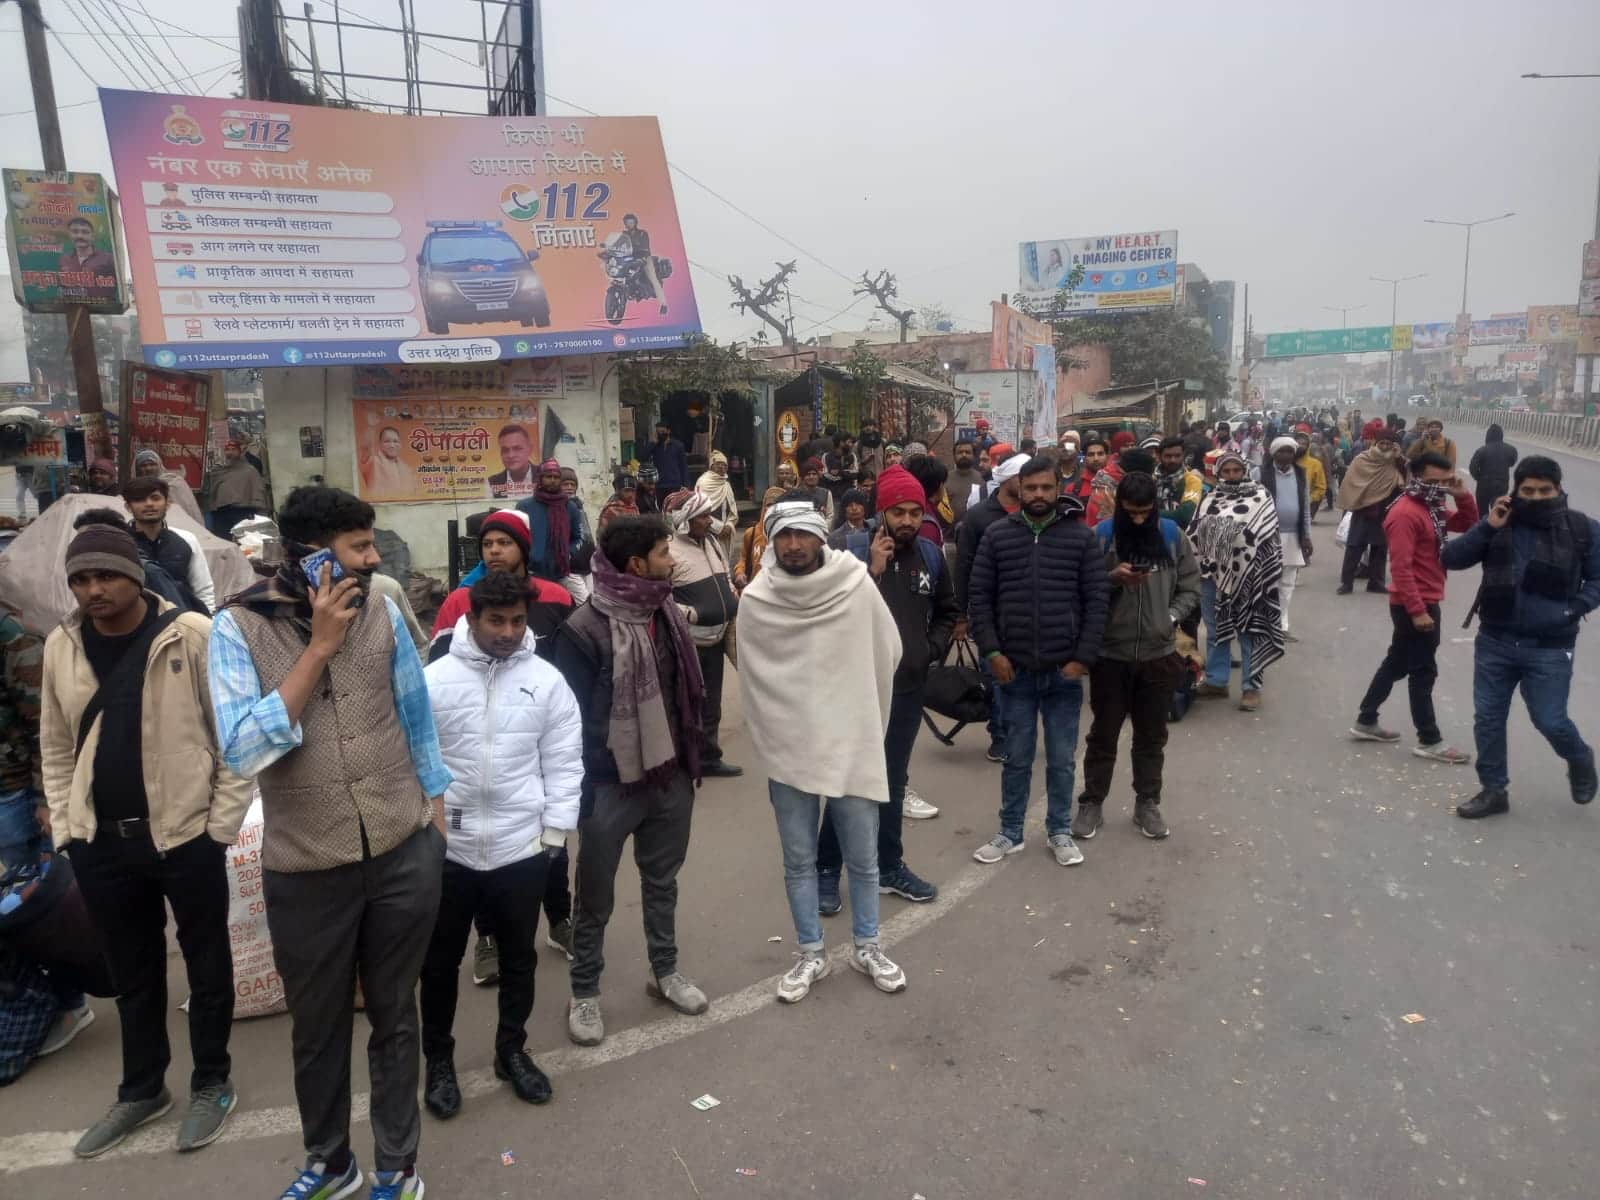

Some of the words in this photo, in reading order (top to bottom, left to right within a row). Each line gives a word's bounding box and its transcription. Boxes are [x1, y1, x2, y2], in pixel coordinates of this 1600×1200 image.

[248, 120, 290, 143] 112
[501, 124, 554, 146] किसी
[561, 124, 585, 145] भी
[146, 153, 198, 176] नंबर
[206, 160, 242, 179] एक
[318, 162, 373, 185] अनेक
[470, 159, 536, 176] आपात
[611, 151, 627, 174] में
[191, 187, 225, 204] पुलिस
[228, 190, 272, 202] सम्बन्धी
[276, 193, 318, 204] सहायता
[543, 181, 612, 221] 112
[196, 214, 240, 228] मेडिकल
[243, 217, 287, 230] सम्बन्धी
[290, 220, 333, 231] सहायता
[200, 242, 224, 252] आग
[226, 240, 256, 252] लगने
[258, 244, 273, 253] पर
[277, 244, 320, 255] सहायता
[1096, 238, 1112, 249] MY
[1082, 250, 1127, 264] IMAGING
[1129, 247, 1172, 261] CENTER
[206, 265, 256, 280] प्राकृतिक
[260, 268, 294, 278] आपदा
[298, 265, 306, 277] में
[311, 269, 353, 279] सहायता
[207, 292, 239, 308] घरेलू
[239, 292, 266, 305] हिंसा
[269, 292, 280, 304] के
[284, 292, 319, 304] मामलों
[322, 292, 331, 304] में
[333, 295, 375, 305] सहायता
[214, 317, 240, 329] रेलवे
[333, 317, 349, 331] ट्रेन
[352, 315, 361, 328] में
[362, 319, 405, 330] सहायता
[179, 352, 269, 364] @112uttarpradesh
[305, 350, 386, 361] @112uttarpradesh
[407, 348, 431, 358] उत्तर
[434, 344, 460, 359] प्रदेश
[463, 343, 493, 360] पुलिस
[409, 427, 491, 452] दीपावली
[233, 849, 262, 867] M-3
